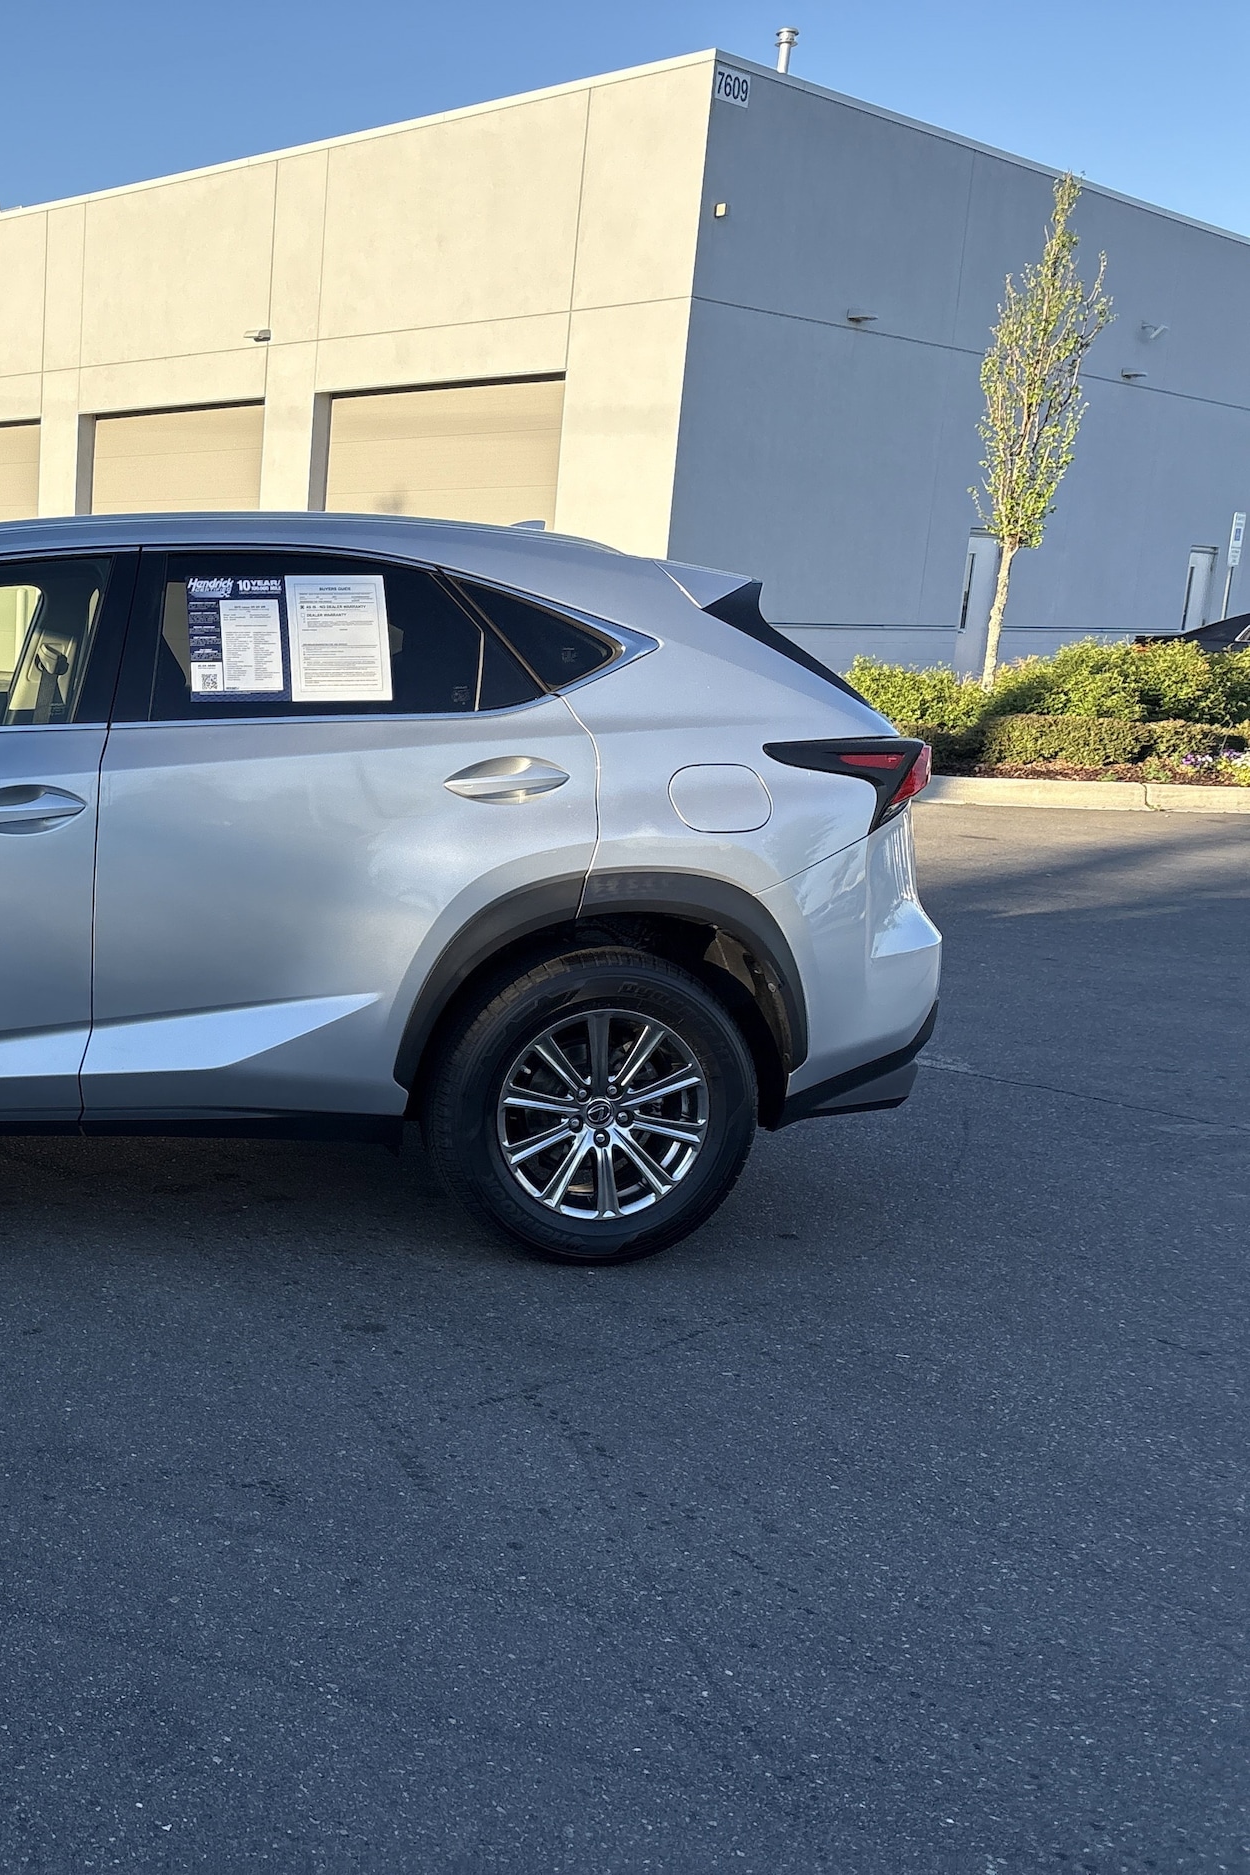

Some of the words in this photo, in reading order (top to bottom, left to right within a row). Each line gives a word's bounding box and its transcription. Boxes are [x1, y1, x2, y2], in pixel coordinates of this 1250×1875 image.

[717, 71, 749, 102] 7609
[187, 577, 234, 592] Hendrick
[237, 580, 250, 591] 10
